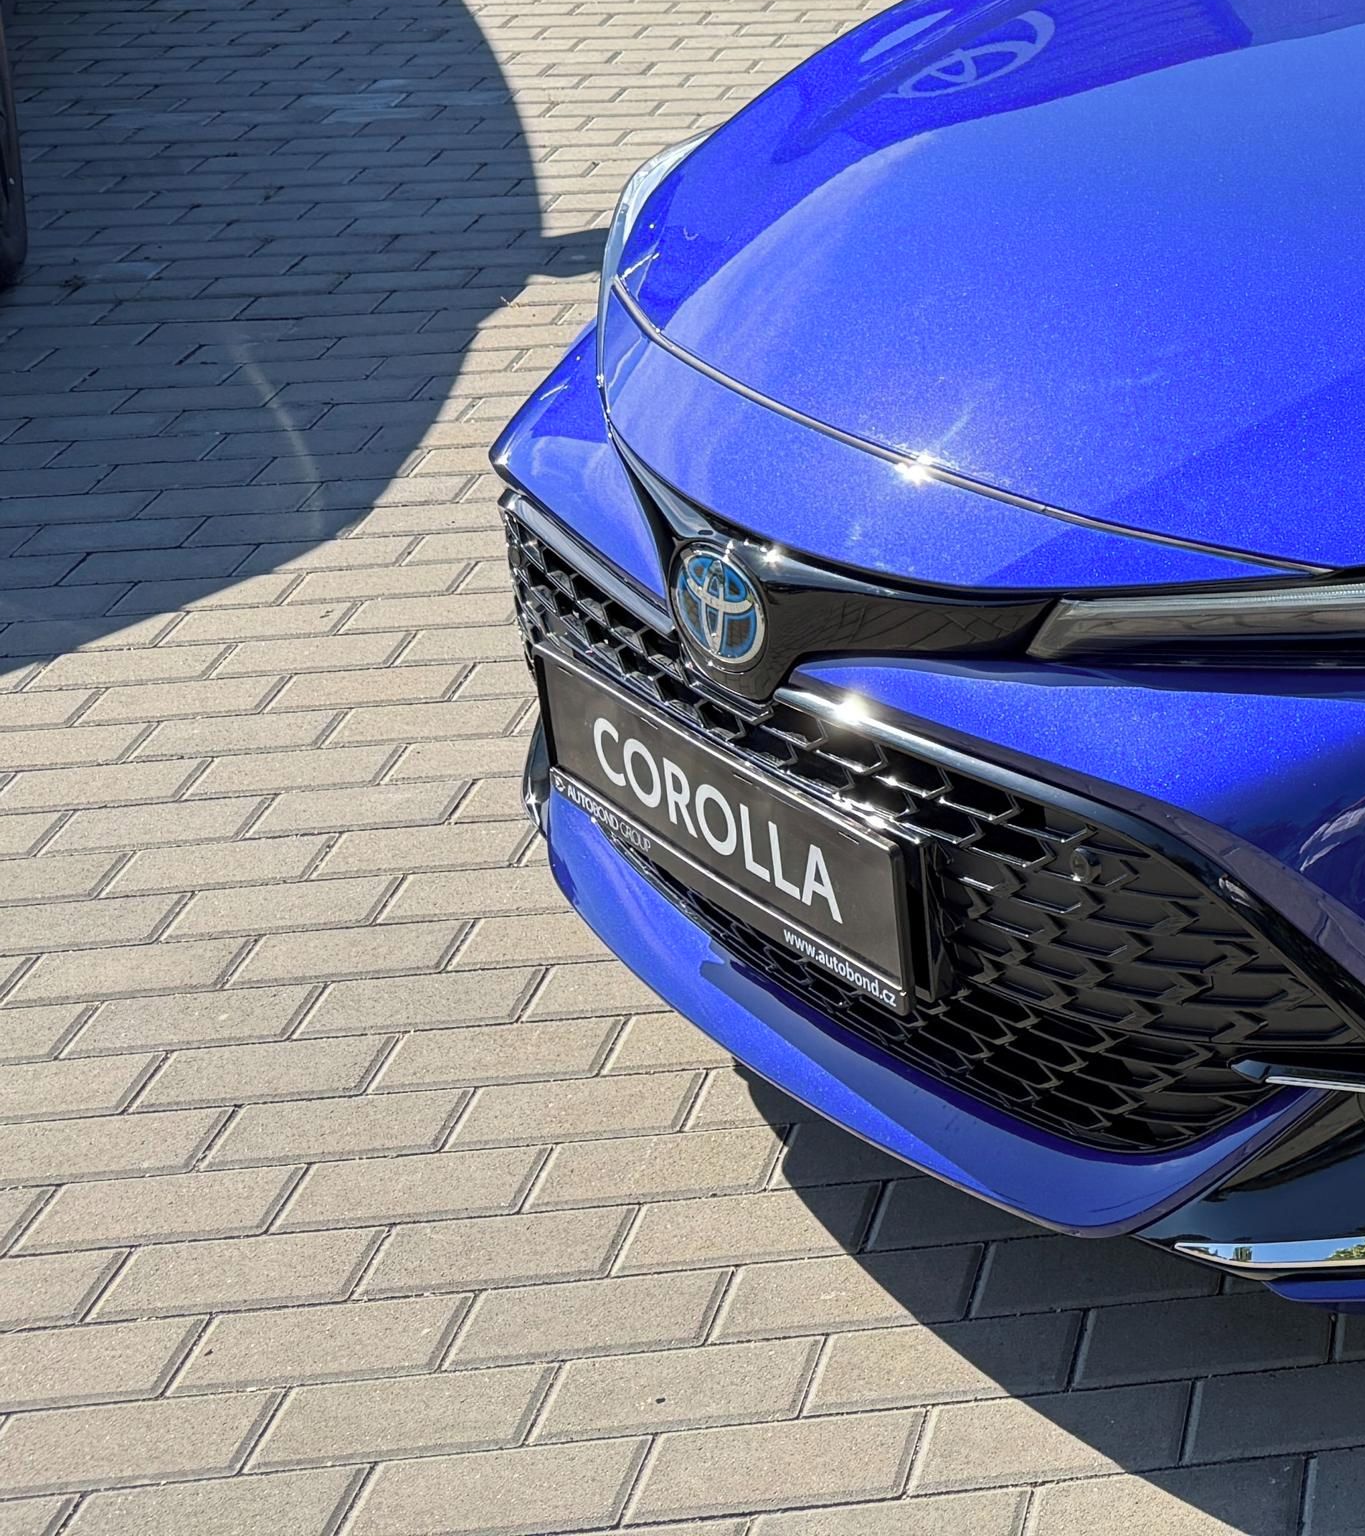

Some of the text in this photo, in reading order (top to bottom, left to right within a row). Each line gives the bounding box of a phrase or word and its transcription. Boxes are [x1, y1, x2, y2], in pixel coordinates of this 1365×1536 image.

[567, 784, 651, 852] AUTOBOND GROUP
[593, 717, 843, 925] COROLLA
[783, 928, 897, 1008] www.autobond.cz
